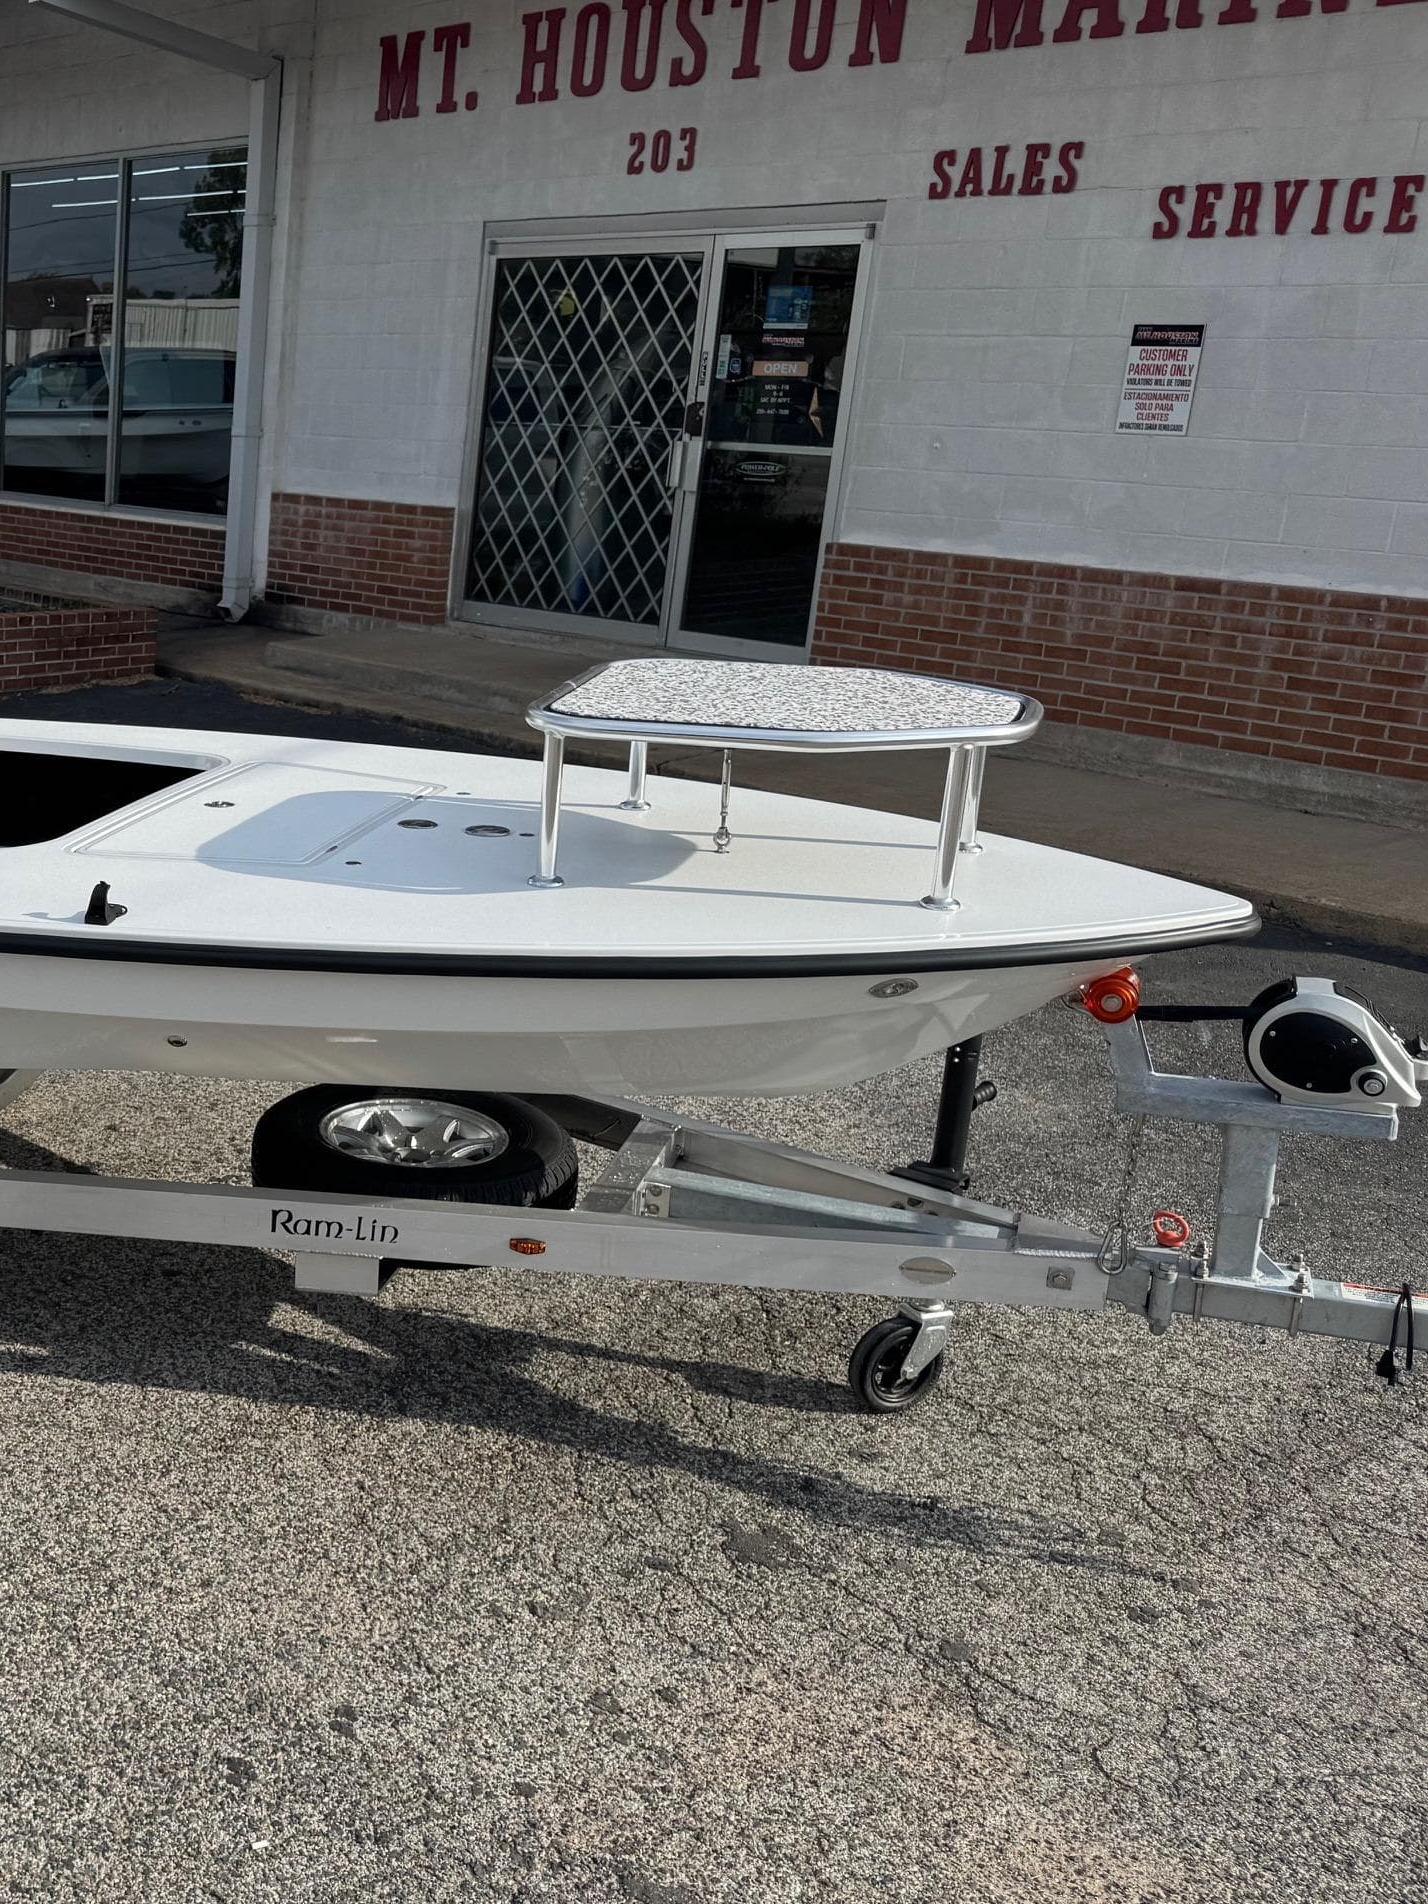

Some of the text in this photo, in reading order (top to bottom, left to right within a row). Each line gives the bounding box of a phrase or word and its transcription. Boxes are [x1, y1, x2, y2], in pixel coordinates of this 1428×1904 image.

[374, 22, 478, 121] MT.
[515, 0, 906, 105] HOUSTON
[627, 126, 699, 175] 203
[928, 141, 1085, 199] SALES
[1152, 175, 1426, 240] SERVICE
[1139, 348, 1189, 361] CUSTOMER
[763, 363, 797, 374] OPEN
[1128, 363, 1195, 377] PARKING ONLY
[1123, 391, 1190, 402] ESTACIONAMIENTO
[1135, 402, 1174, 412] SOLO PARA
[1136, 412, 1170, 422] CLIENTES
[271, 1209, 399, 1244] Ram-Lin
